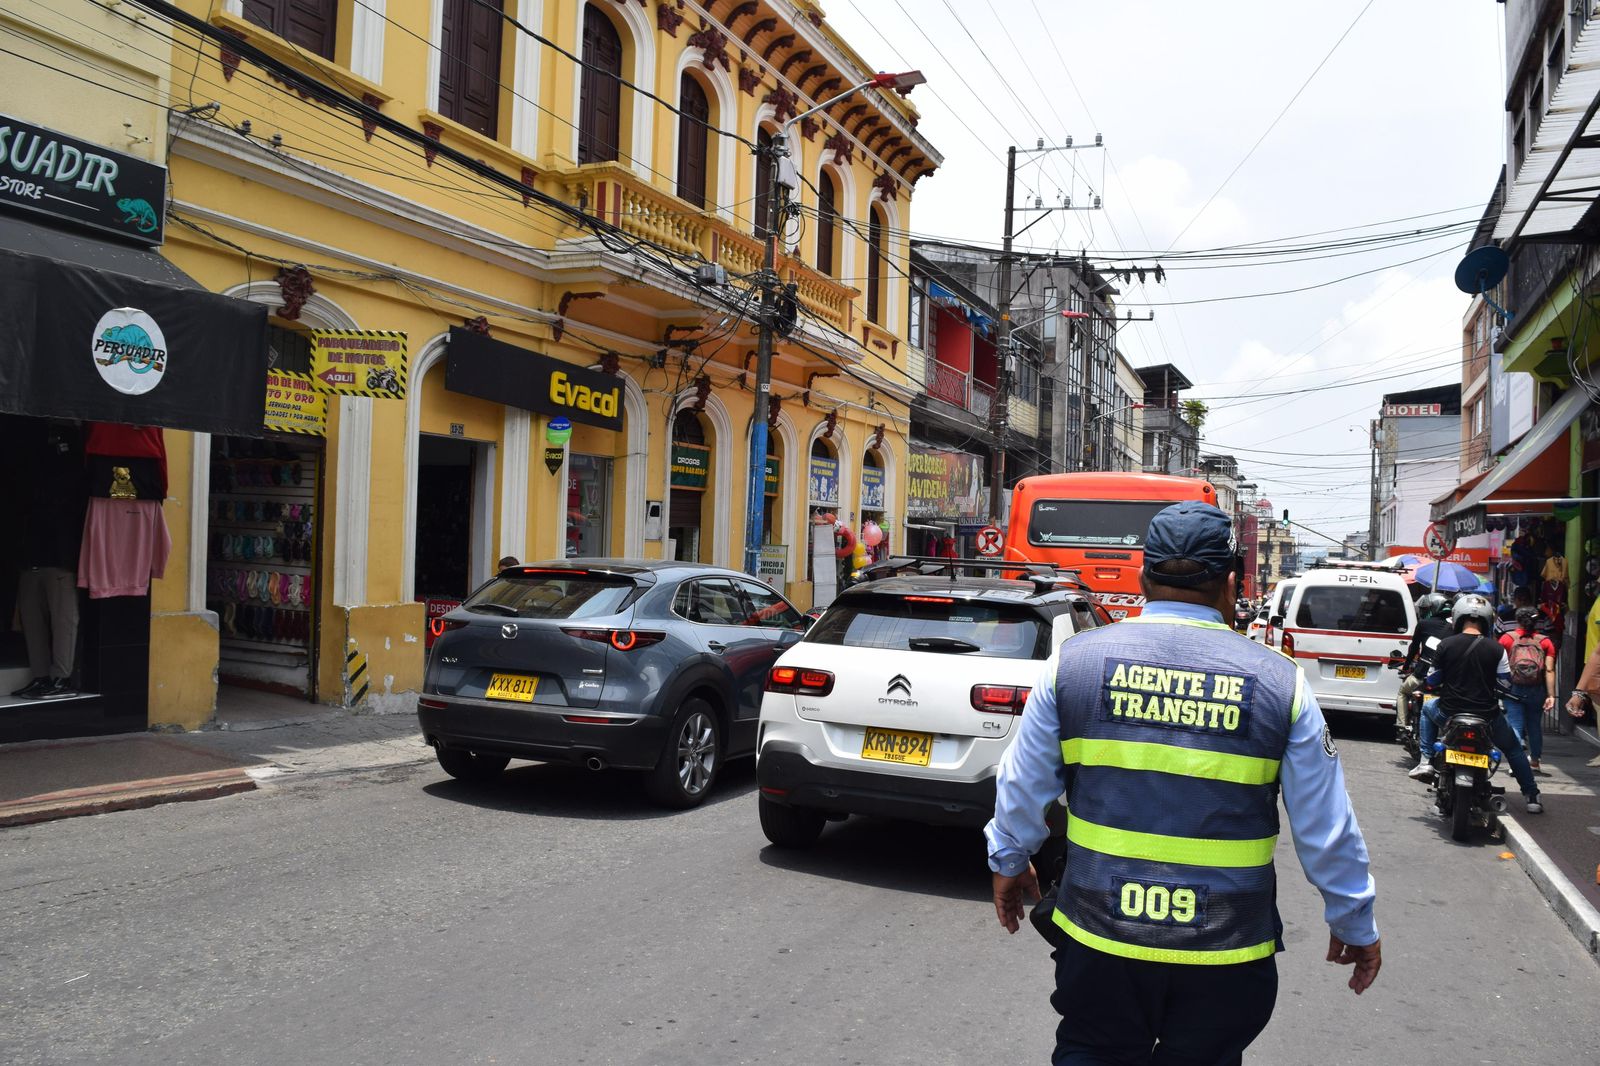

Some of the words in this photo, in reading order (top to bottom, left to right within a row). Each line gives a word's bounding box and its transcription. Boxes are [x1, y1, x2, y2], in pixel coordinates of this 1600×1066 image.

[0, 175, 44, 200] STORE
[94, 338, 166, 362] PERSUADIR
[317, 336, 401, 352] PARQUEADERO
[327, 352, 343, 363] DE
[344, 353, 386, 365] MOTOS
[281, 377, 292, 389] DE
[326, 372, 353, 383] AQUÍ
[294, 393, 315, 404] ORO
[549, 371, 619, 418] Evacol
[1386, 405, 1439, 416] HOTEL
[545, 451, 563, 460] Evacol
[677, 457, 701, 466] DROGAS
[924, 453, 947, 475] BODEGA
[1338, 574, 1378, 584] DFSK
[1109, 663, 1206, 698] AGENTE
[1211, 674, 1245, 702] DE
[1109, 690, 1241, 731] TRANSITO
[982, 721, 1001, 731] C4
[1120, 882, 1197, 923] 009
